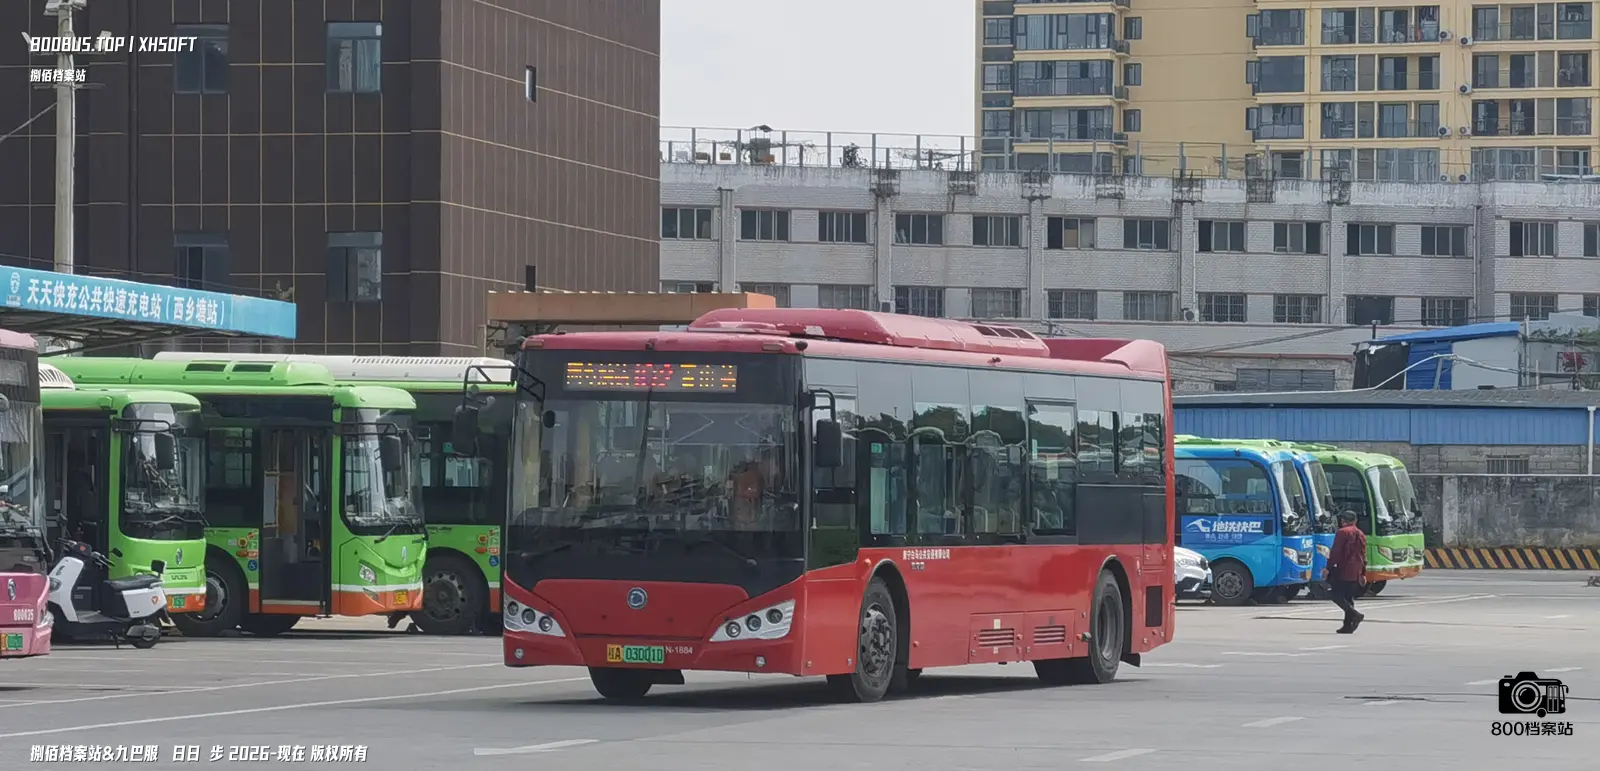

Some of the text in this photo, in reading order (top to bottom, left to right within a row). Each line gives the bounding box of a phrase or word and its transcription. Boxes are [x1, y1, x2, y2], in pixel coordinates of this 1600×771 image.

[1212, 521, 1263, 532] 地铁快巴
[665, 646, 693, 654] N-1884
